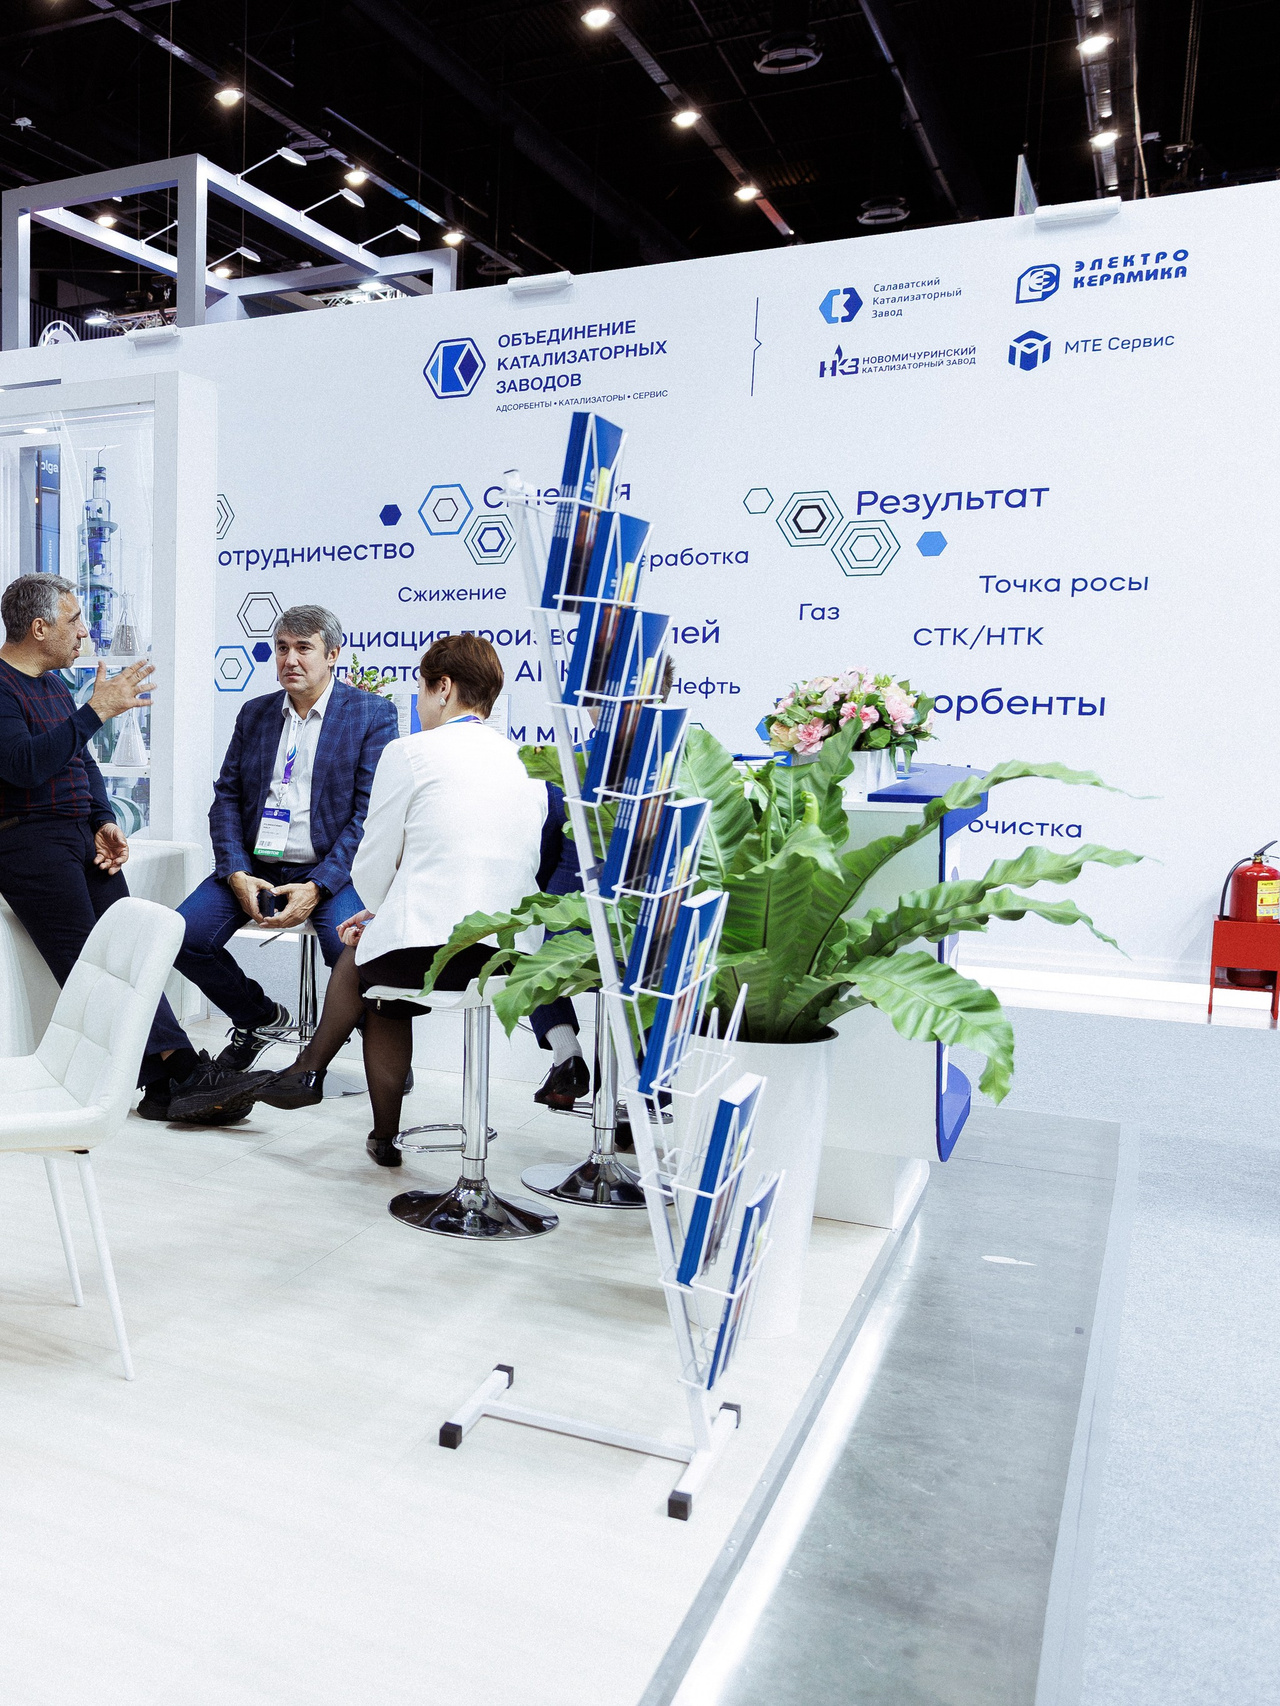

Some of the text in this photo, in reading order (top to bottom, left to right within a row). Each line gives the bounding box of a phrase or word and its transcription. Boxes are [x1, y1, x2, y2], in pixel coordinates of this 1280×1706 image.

[1074, 248, 1189, 273] ЭЛЕКТРО
[873, 276, 941, 293] Салаватский
[1072, 264, 1188, 289] КЕРАМИКА
[872, 287, 962, 306] Катализаторный
[871, 308, 903, 319] Завод
[498, 320, 636, 348] ОБЪЕДИНЕНИЕ
[1107, 335, 1175, 352] Сервис
[497, 340, 668, 371] КАТАЛИЗАТОРНЫХ
[861, 344, 977, 366] НОВОМИЧУРИНСКИЙ
[861, 357, 977, 374] КАТАЛИЗАТОРНЫЙ ЗАВОД
[495, 372, 582, 395] ЗАВОДОВ
[495, 389, 669, 413] АДСОРБЕНТЫ КАТАЛИЗАТОРЫ СЕРВИС
[856, 487, 1050, 520] Результат
[217, 542, 415, 571] отрудничество
[643, 547, 749, 572] работка
[398, 587, 507, 602] Сжижение
[979, 575, 1149, 597] Точка росы
[799, 603, 840, 621] Газ
[913, 625, 1045, 650] СТК/НТК
[932, 687, 1106, 722] орбенты
[968, 819, 1083, 839] очистка
